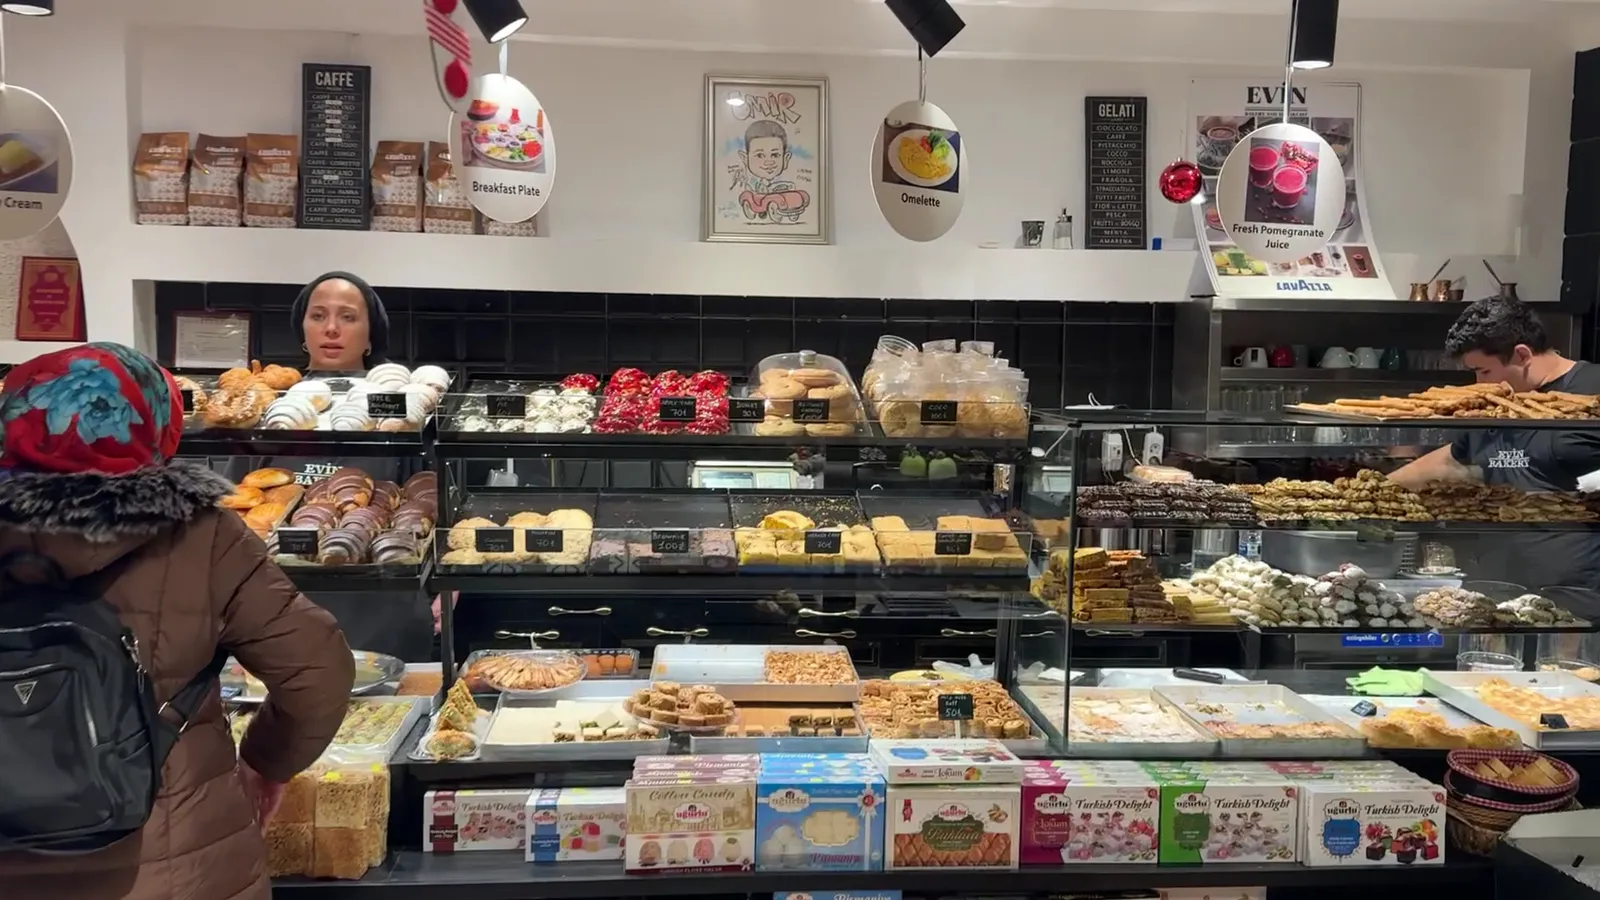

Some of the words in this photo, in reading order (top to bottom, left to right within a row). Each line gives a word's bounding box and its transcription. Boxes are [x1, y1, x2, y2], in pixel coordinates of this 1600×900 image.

[315, 71, 354, 87] CAFFÈ
[1099, 104, 1136, 117] GELATI
[472, 181, 517, 195] Breakfast
[518, 184, 540, 197] Plate
[4, 197, 43, 209] Cream
[901, 193, 941, 208] Omelette
[1232, 223, 1259, 234] Fresh
[1260, 225, 1324, 238] Pomegranate
[1265, 239, 1290, 250] Juice
[1276, 280, 1333, 292] LAVAZZA
[461, 803, 492, 811] Turkish
[1075, 799, 1113, 809] Turkish
[1113, 799, 1153, 812] Delight
[1214, 799, 1251, 809] Turkish
[1252, 799, 1290, 811] Delight
[1364, 804, 1401, 815] Turkish
[1401, 804, 1440, 817] Delight
